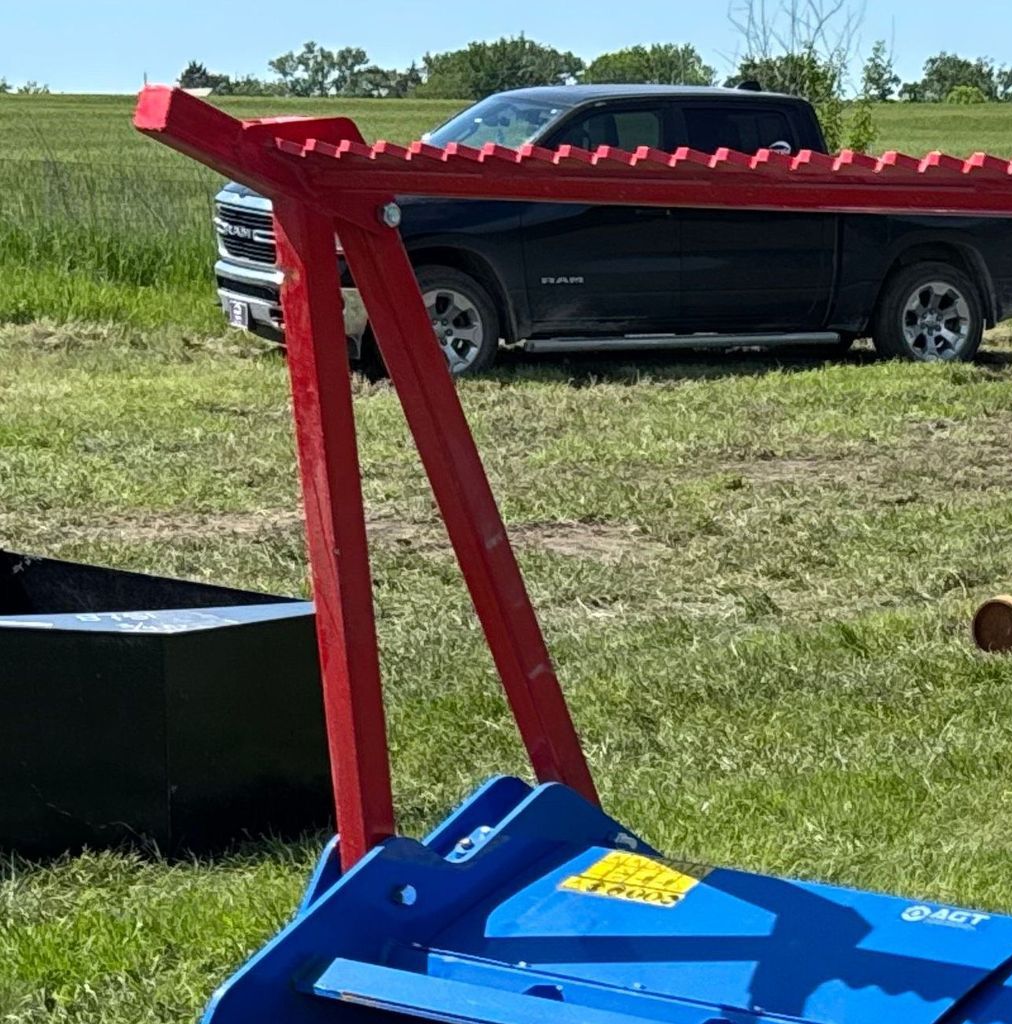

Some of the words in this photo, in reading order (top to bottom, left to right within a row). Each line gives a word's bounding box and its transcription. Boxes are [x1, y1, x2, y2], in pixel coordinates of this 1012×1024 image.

[223, 224, 253, 239] RAM
[541, 276, 584, 284] RAM
[929, 908, 991, 926] AGT
